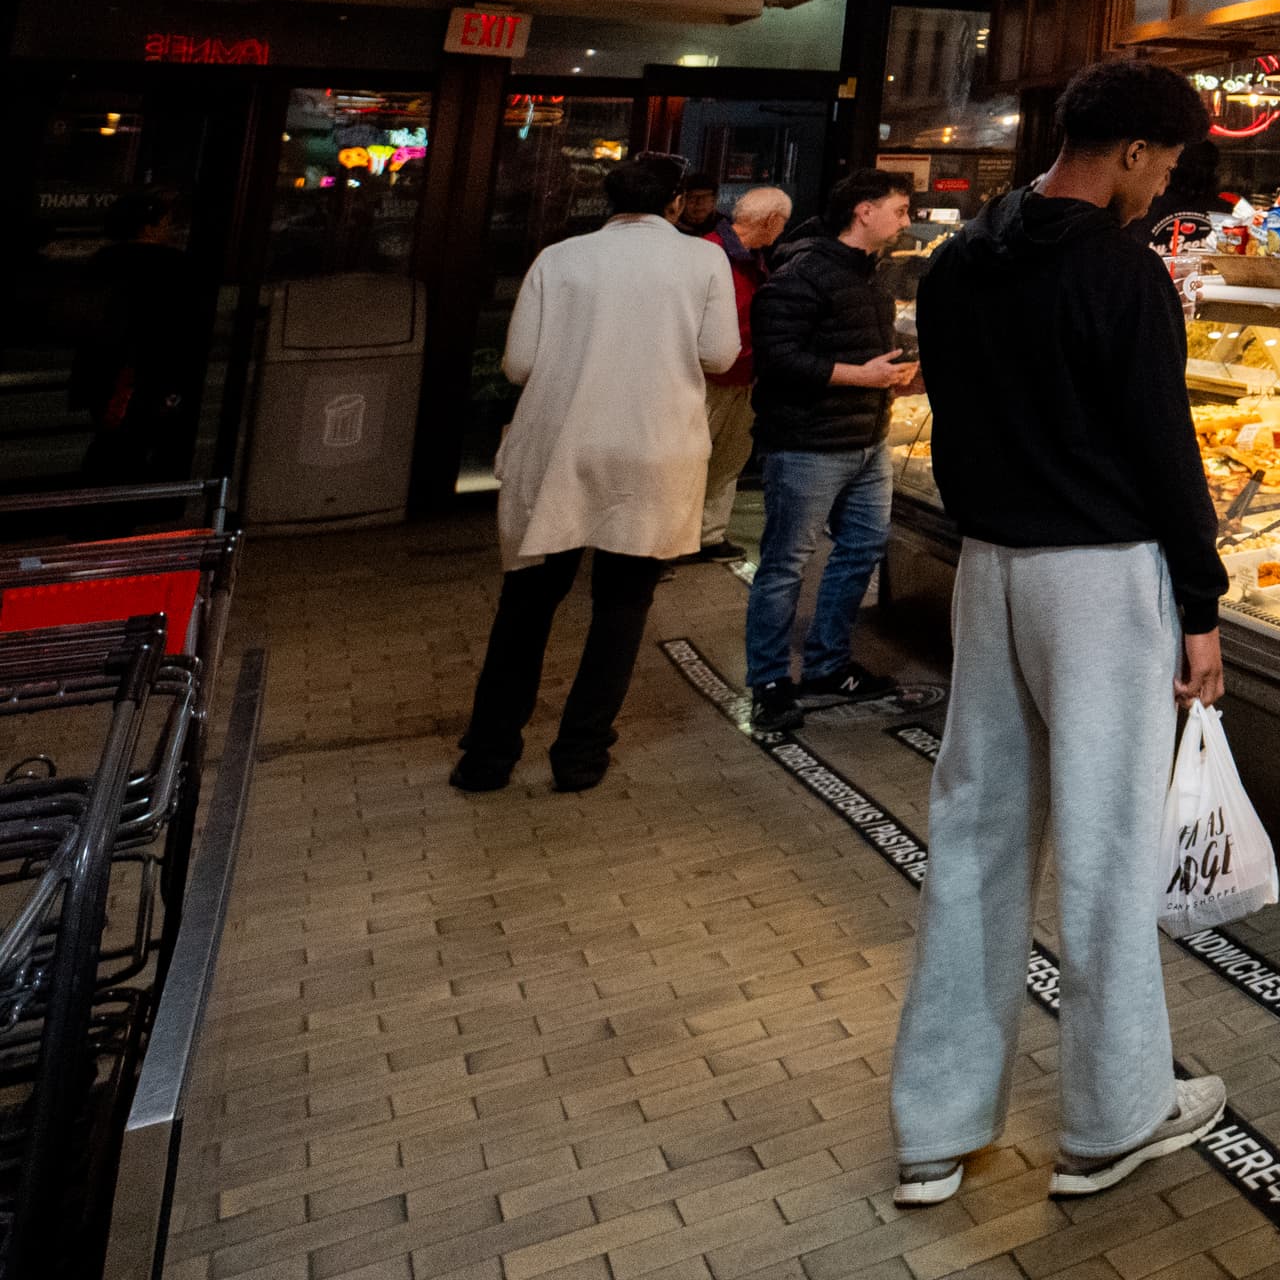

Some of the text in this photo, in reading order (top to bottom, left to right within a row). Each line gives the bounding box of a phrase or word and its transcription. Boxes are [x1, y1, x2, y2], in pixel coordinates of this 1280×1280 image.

[461, 11, 520, 50] EXIT
[39, 193, 86, 209] THANK
[772, 743, 817, 776] ORDER
[1193, 886, 1238, 908] SHOPPE
